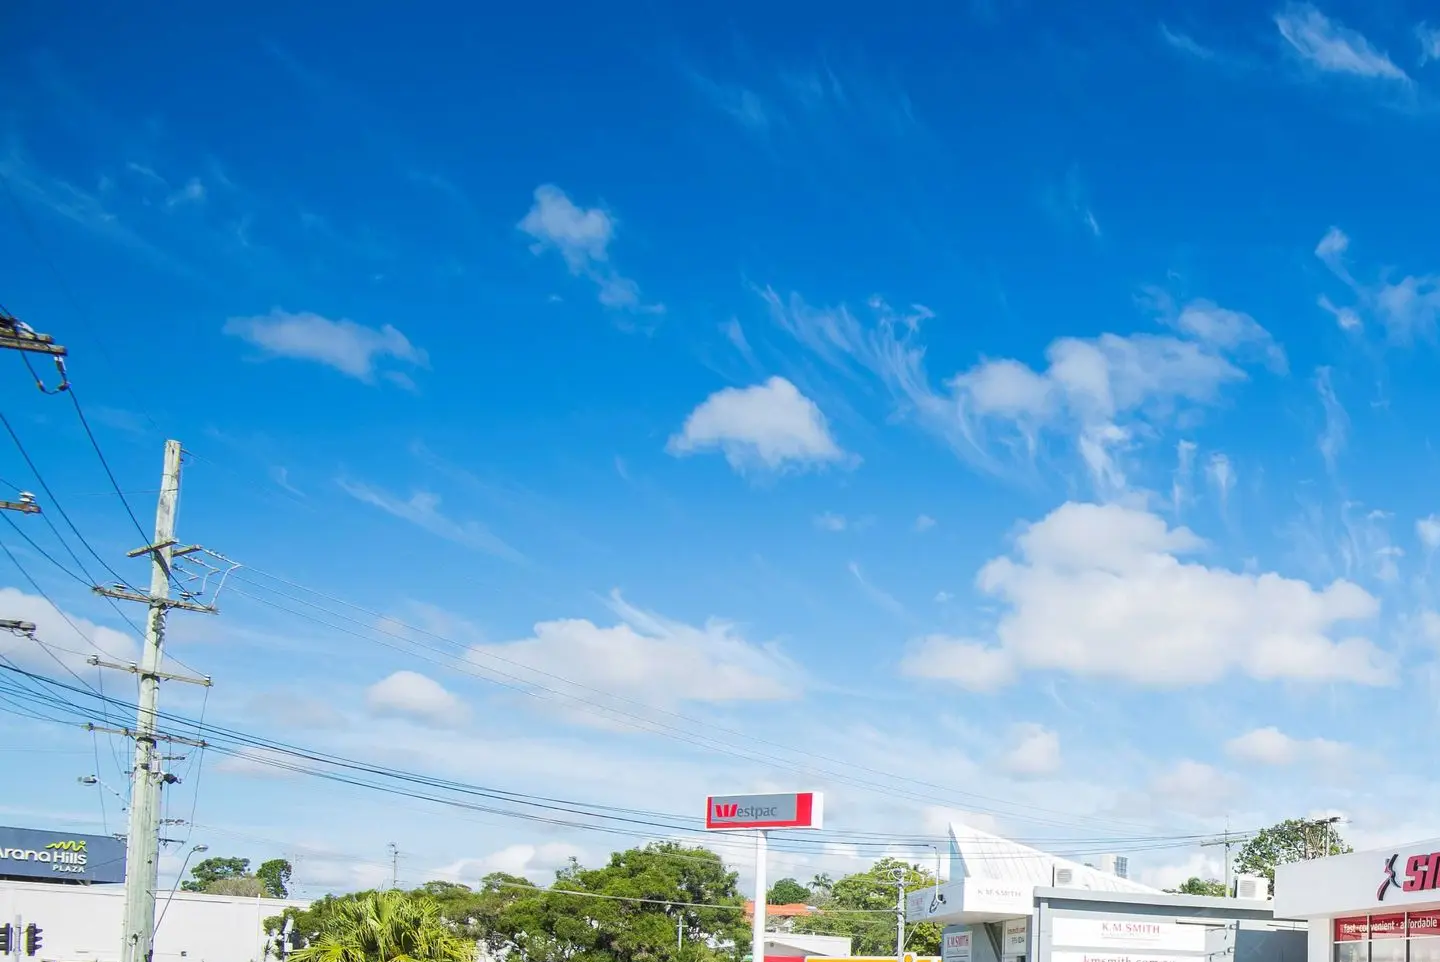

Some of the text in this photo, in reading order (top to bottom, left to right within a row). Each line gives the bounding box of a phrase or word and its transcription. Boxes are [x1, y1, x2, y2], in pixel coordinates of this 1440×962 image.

[715, 804, 778, 819] Westpac
[53, 850, 88, 866] Hills
[52, 864, 86, 873] PLAZA
